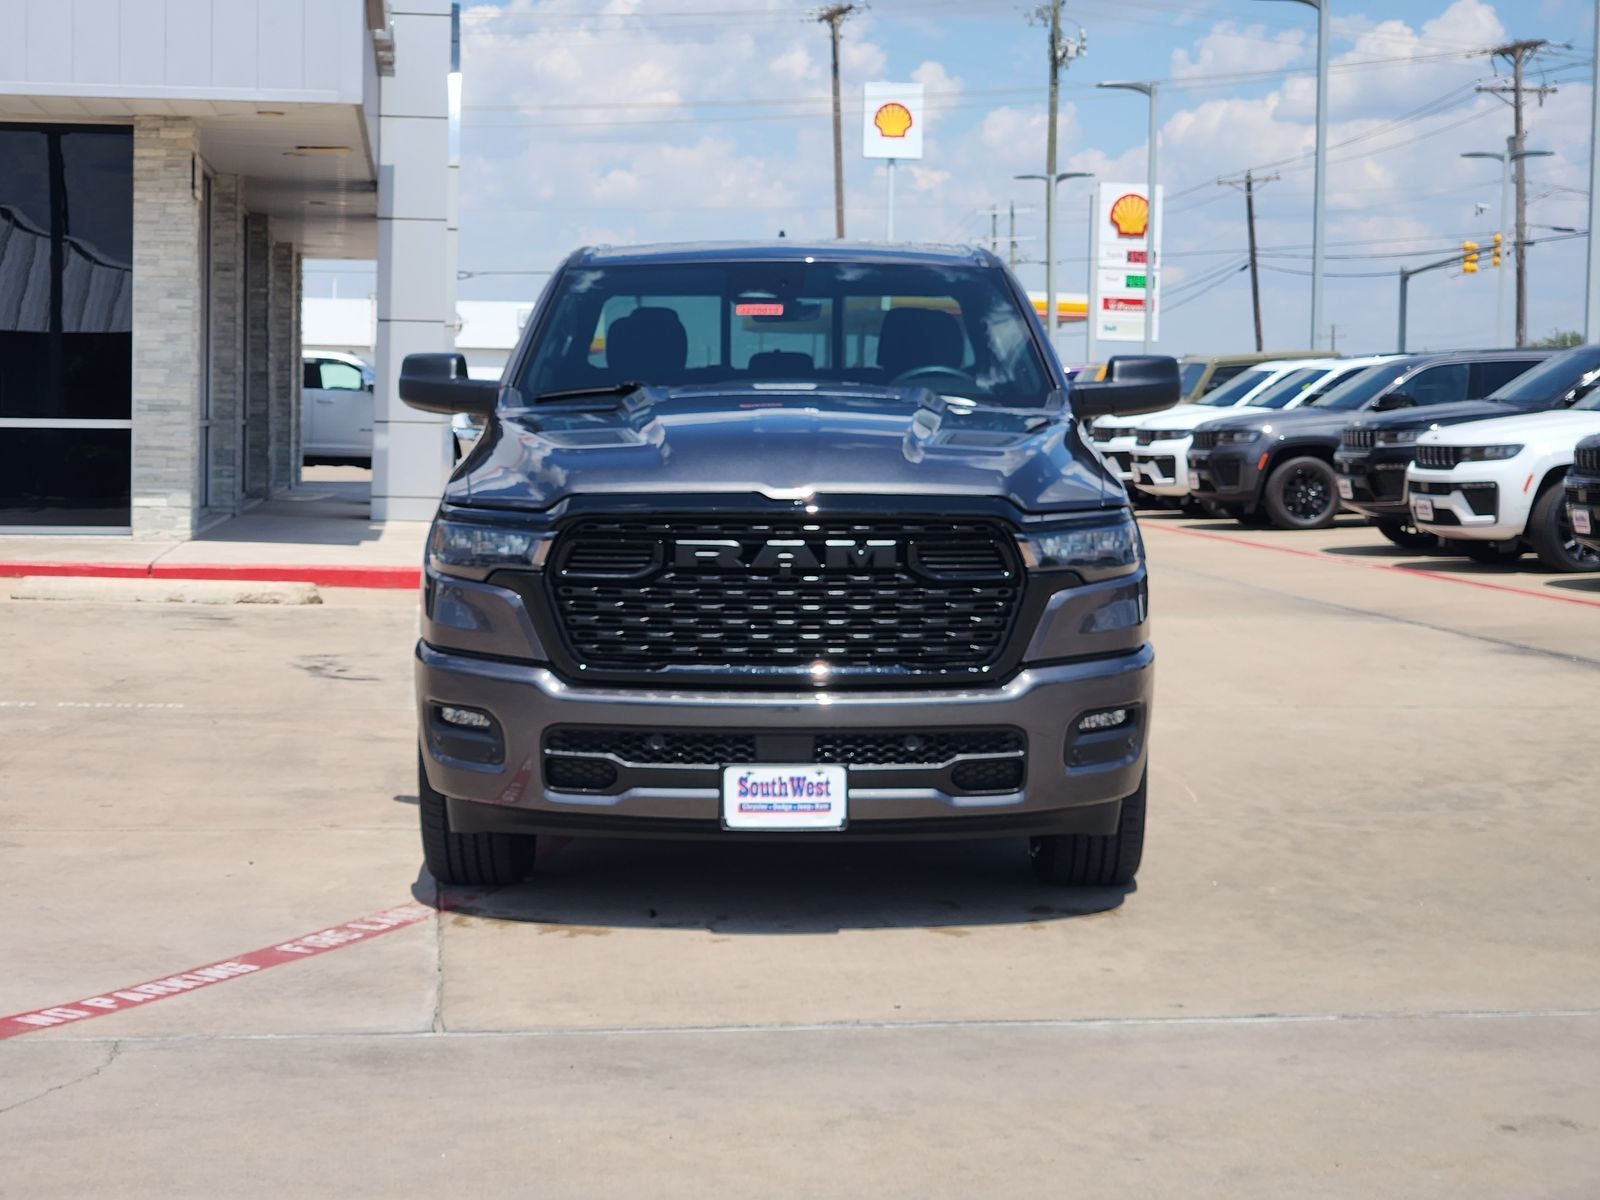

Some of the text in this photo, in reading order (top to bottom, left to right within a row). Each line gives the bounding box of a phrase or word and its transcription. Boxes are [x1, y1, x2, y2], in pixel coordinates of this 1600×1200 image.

[675, 539, 897, 568] RAM
[738, 776, 832, 797] SouthWest
[14, 907, 425, 1027] NO PARKING FIRE LAN
